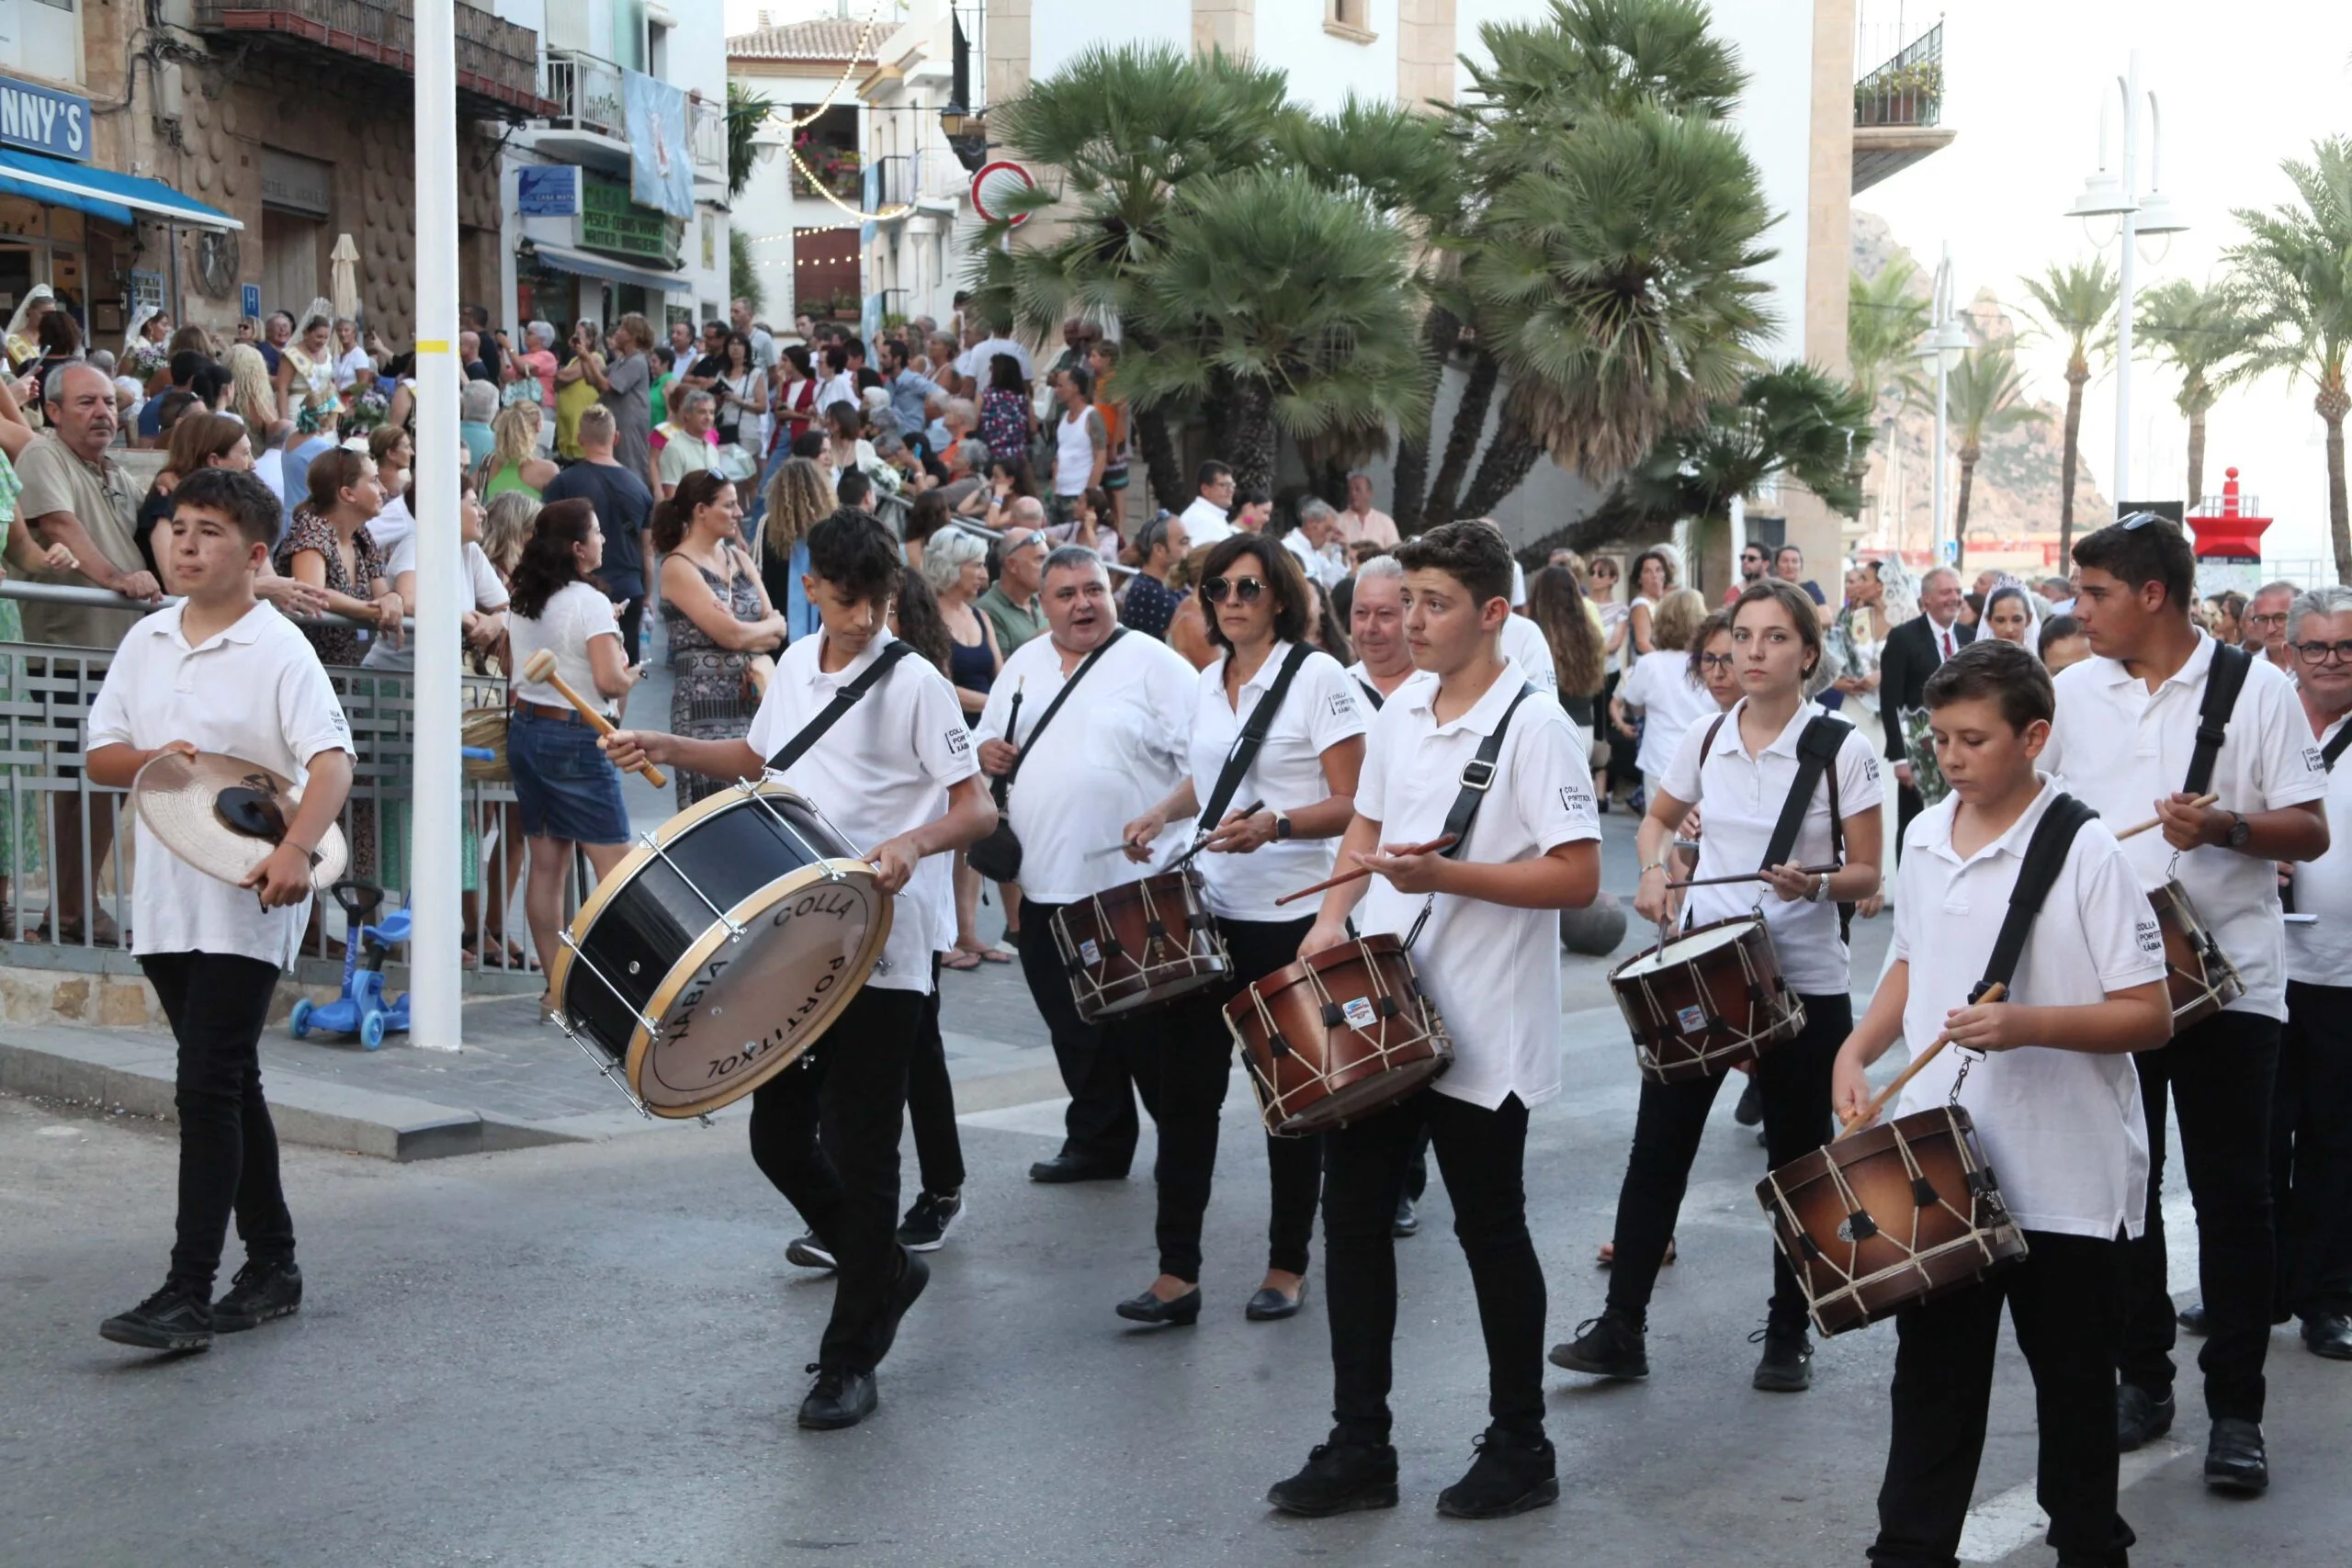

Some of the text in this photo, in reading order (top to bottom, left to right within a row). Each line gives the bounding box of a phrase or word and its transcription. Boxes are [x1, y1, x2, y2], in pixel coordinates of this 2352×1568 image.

[0, 86, 83, 152] NNY'S
[247, 287, 256, 310] H
[774, 893, 854, 927] COLLA
[707, 955, 846, 1078] PORTITXOL
